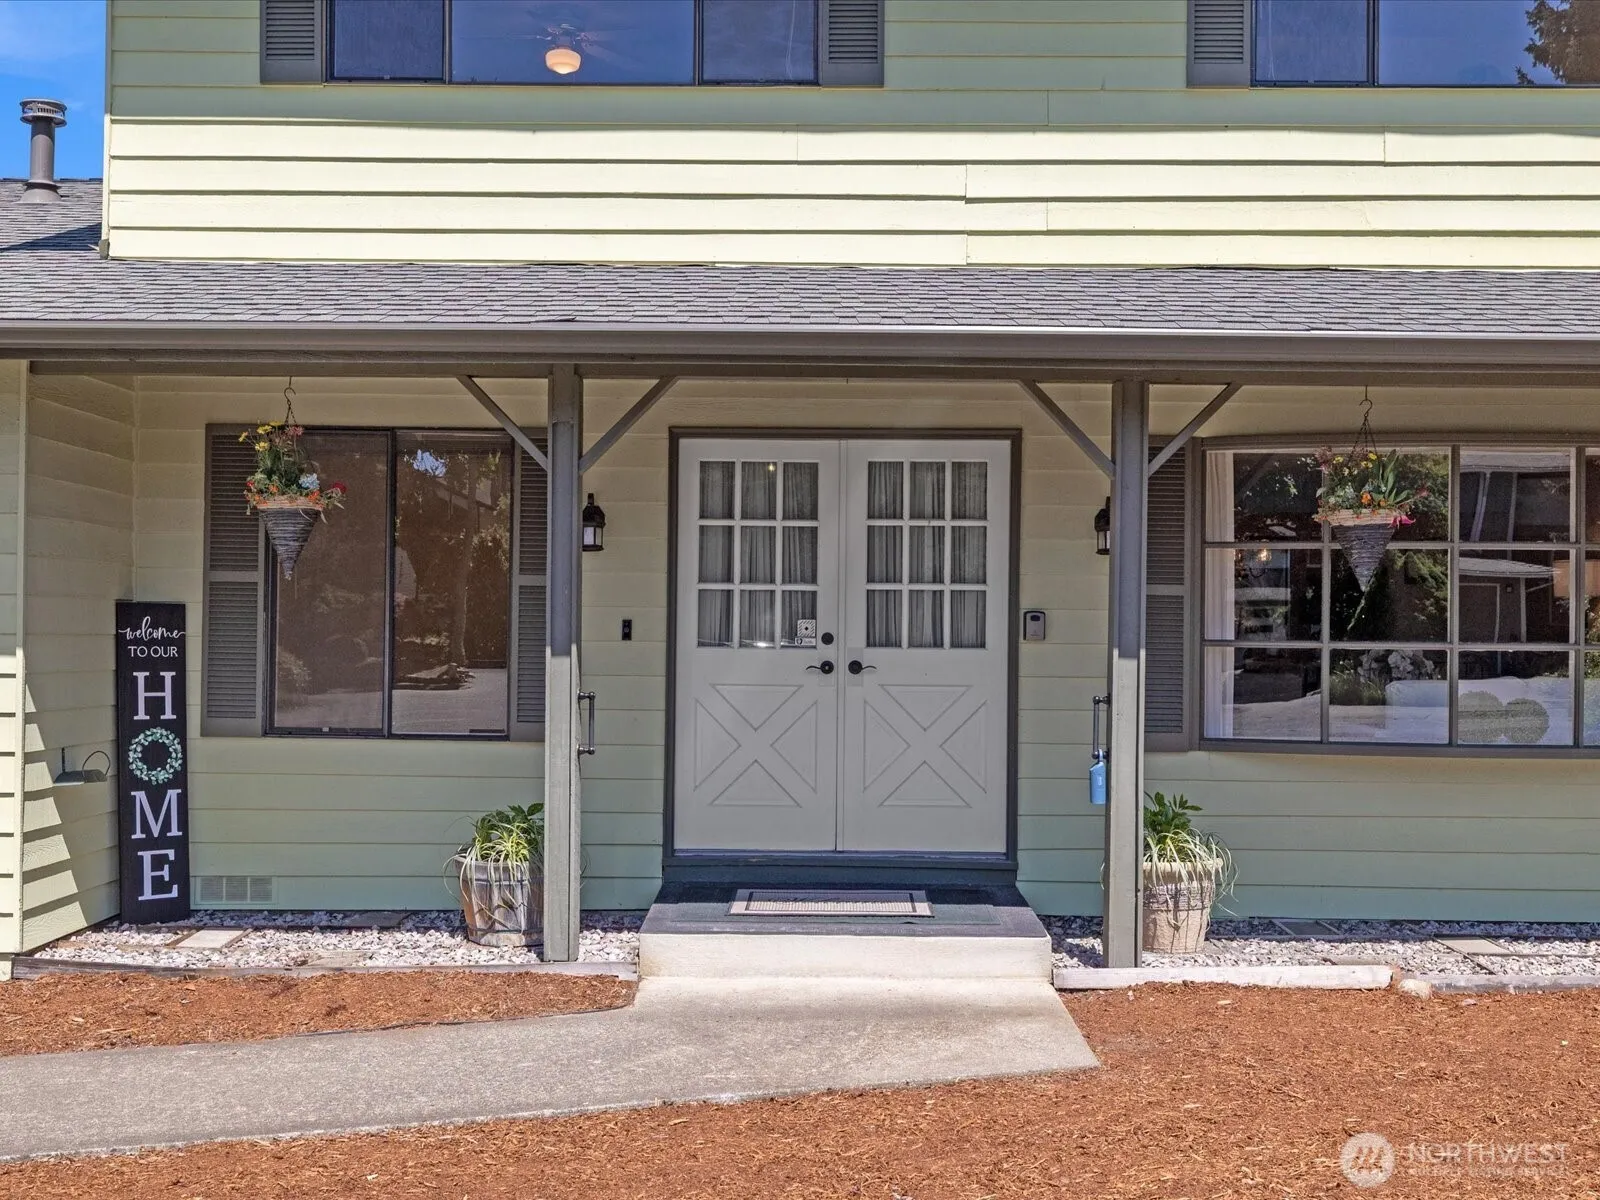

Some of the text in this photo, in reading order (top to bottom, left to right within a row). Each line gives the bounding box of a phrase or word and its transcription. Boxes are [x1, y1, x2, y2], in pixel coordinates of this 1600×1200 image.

[118, 616, 186, 641] welcome
[128, 646, 178, 657] TO OUR
